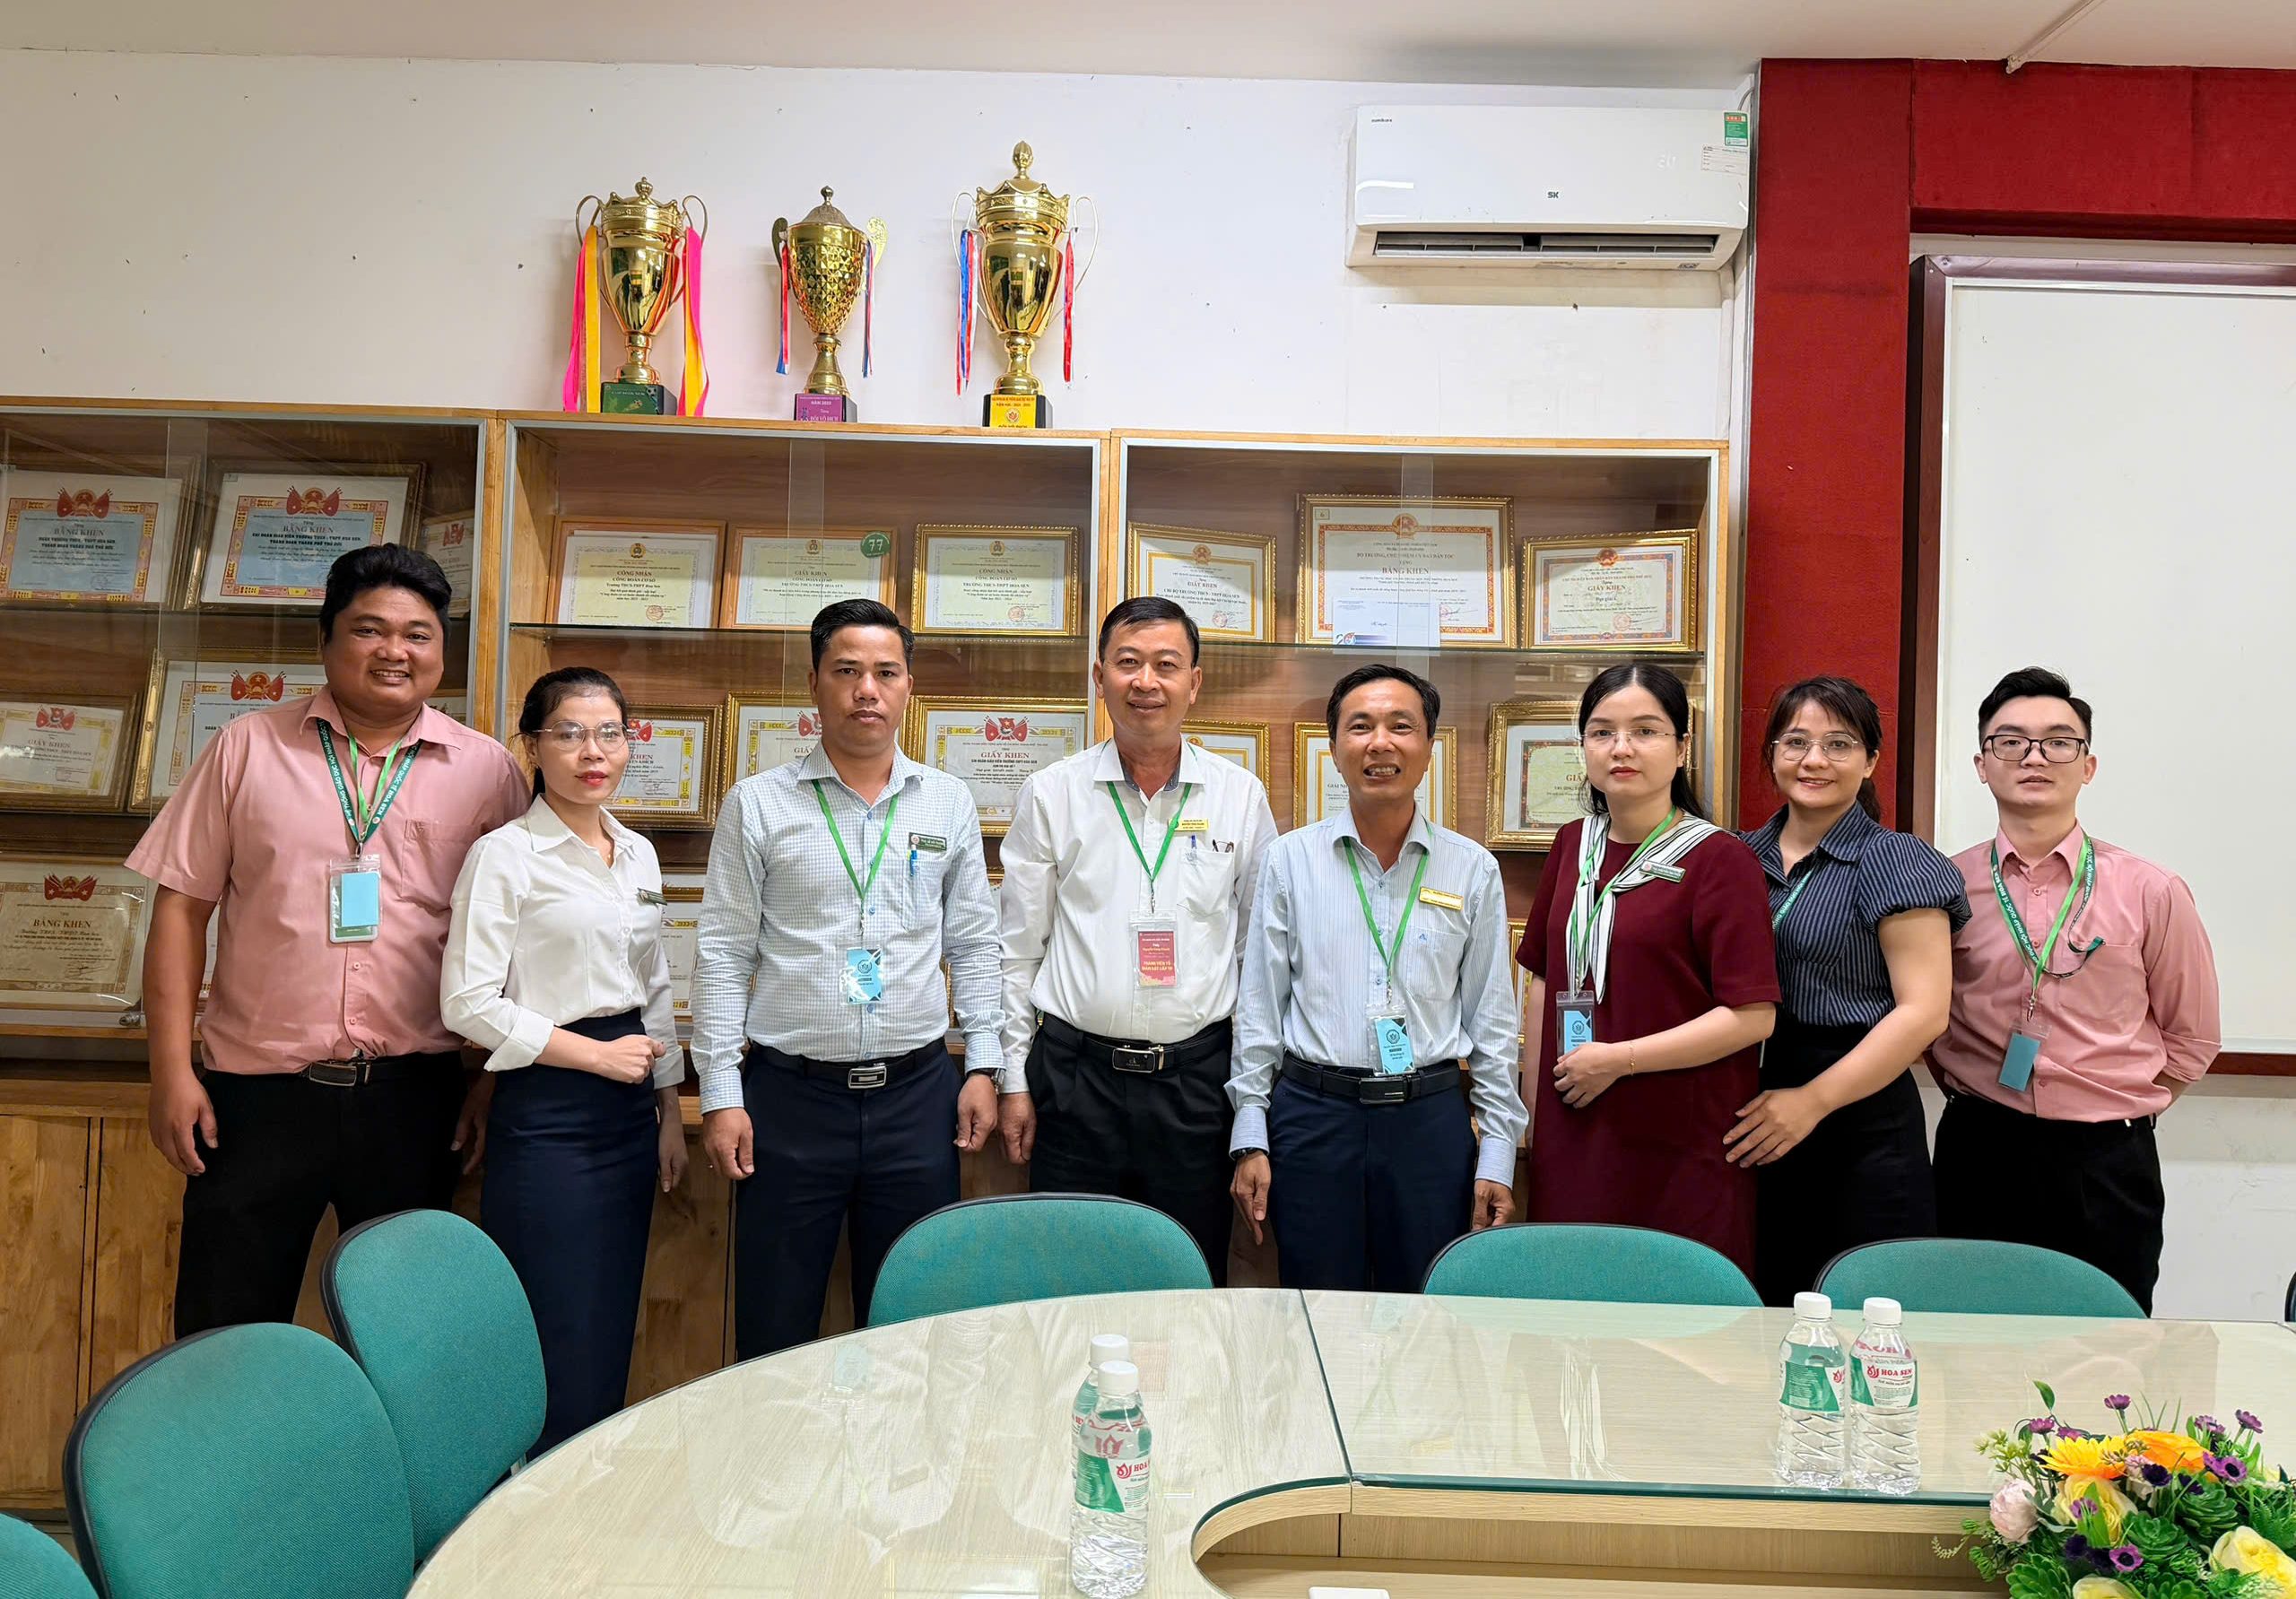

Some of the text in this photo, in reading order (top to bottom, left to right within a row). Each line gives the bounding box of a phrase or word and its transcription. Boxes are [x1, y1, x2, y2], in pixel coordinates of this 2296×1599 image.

[1547, 191, 1559, 199] SK
[868, 539, 883, 552] 77
[1382, 566, 1405, 575] BẰNG
[318, 726, 328, 741] QUỐC
[324, 741, 332, 754] NHẬP
[980, 750, 1003, 759] GIẤY
[402, 757, 411, 769] NHẬP
[335, 776, 343, 789] GIÁO
[394, 769, 404, 785] QUỐC
[339, 790, 349, 808] THỐNG
[383, 789, 394, 804] HOA
[377, 802, 387, 816] SEN
[1997, 882, 2006, 896] HOA
[2005, 902, 2016, 918] QUỐC
[33, 916, 91, 929] BẰNG KHEN
[2013, 918, 2023, 934] NHẬP
[2021, 933, 2029, 943] HỘI
